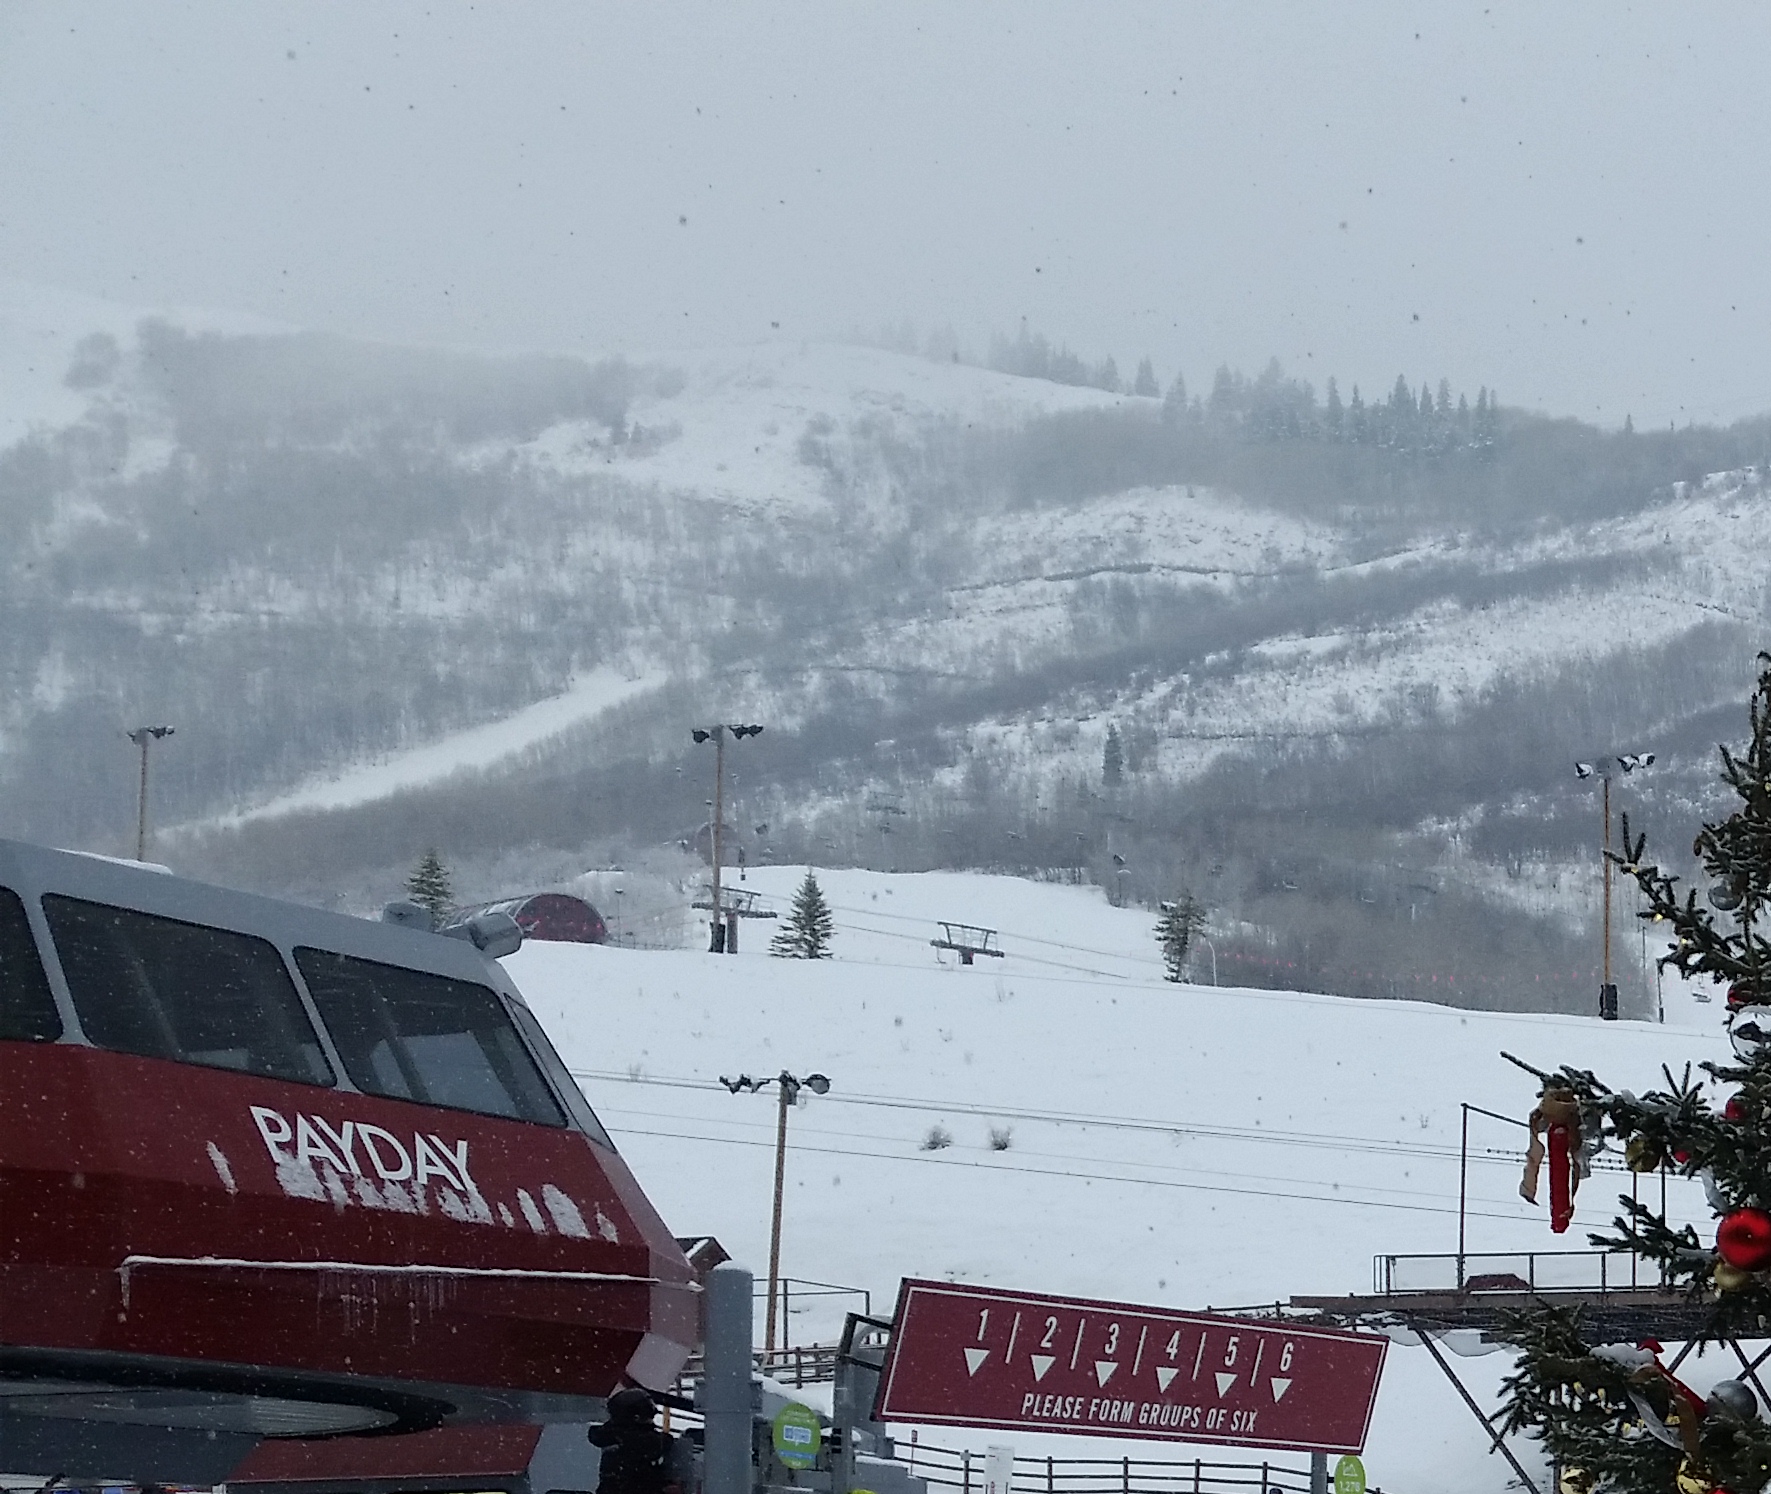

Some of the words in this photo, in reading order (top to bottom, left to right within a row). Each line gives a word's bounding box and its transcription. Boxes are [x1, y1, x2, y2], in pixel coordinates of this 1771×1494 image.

[250, 1105, 471, 1190] PAYDAY
[979, 1309, 989, 1341] 1
[1040, 1316, 1059, 1349] 2
[1105, 1323, 1120, 1355] 3
[1165, 1330, 1181, 1361] 4
[1224, 1336, 1239, 1367] 5
[1280, 1342, 1294, 1372] 6
[1021, 1393, 1084, 1420] PLEASE
[1088, 1398, 1134, 1424] FORM
[1138, 1402, 1201, 1430] GROUPS
[1206, 1408, 1226, 1431] OF
[1230, 1410, 1258, 1433] SIX
